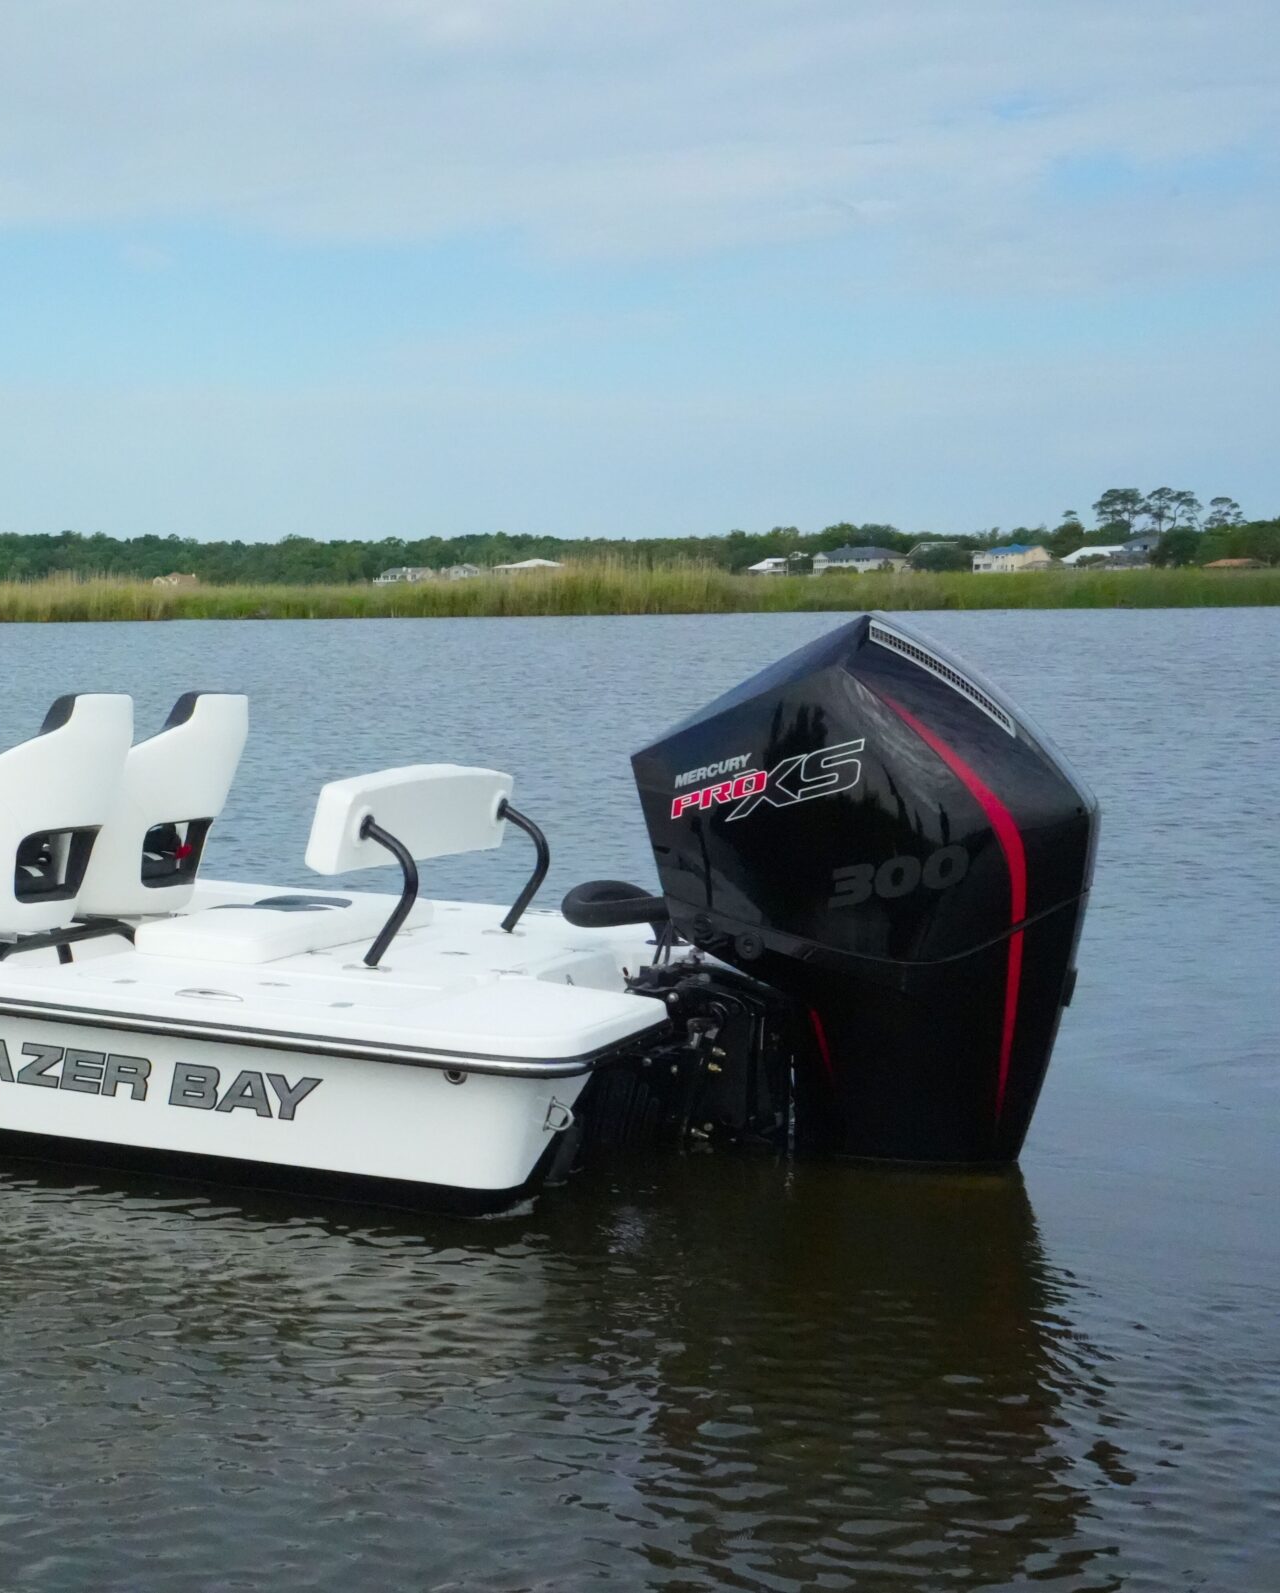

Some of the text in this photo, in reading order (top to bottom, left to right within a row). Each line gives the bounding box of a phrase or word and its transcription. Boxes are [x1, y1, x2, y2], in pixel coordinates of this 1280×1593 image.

[671, 738, 866, 823] PRO XS
[674, 752, 752, 789] MERCURY
[829, 845, 970, 909] 300
[168, 1061, 324, 1121] BAY
